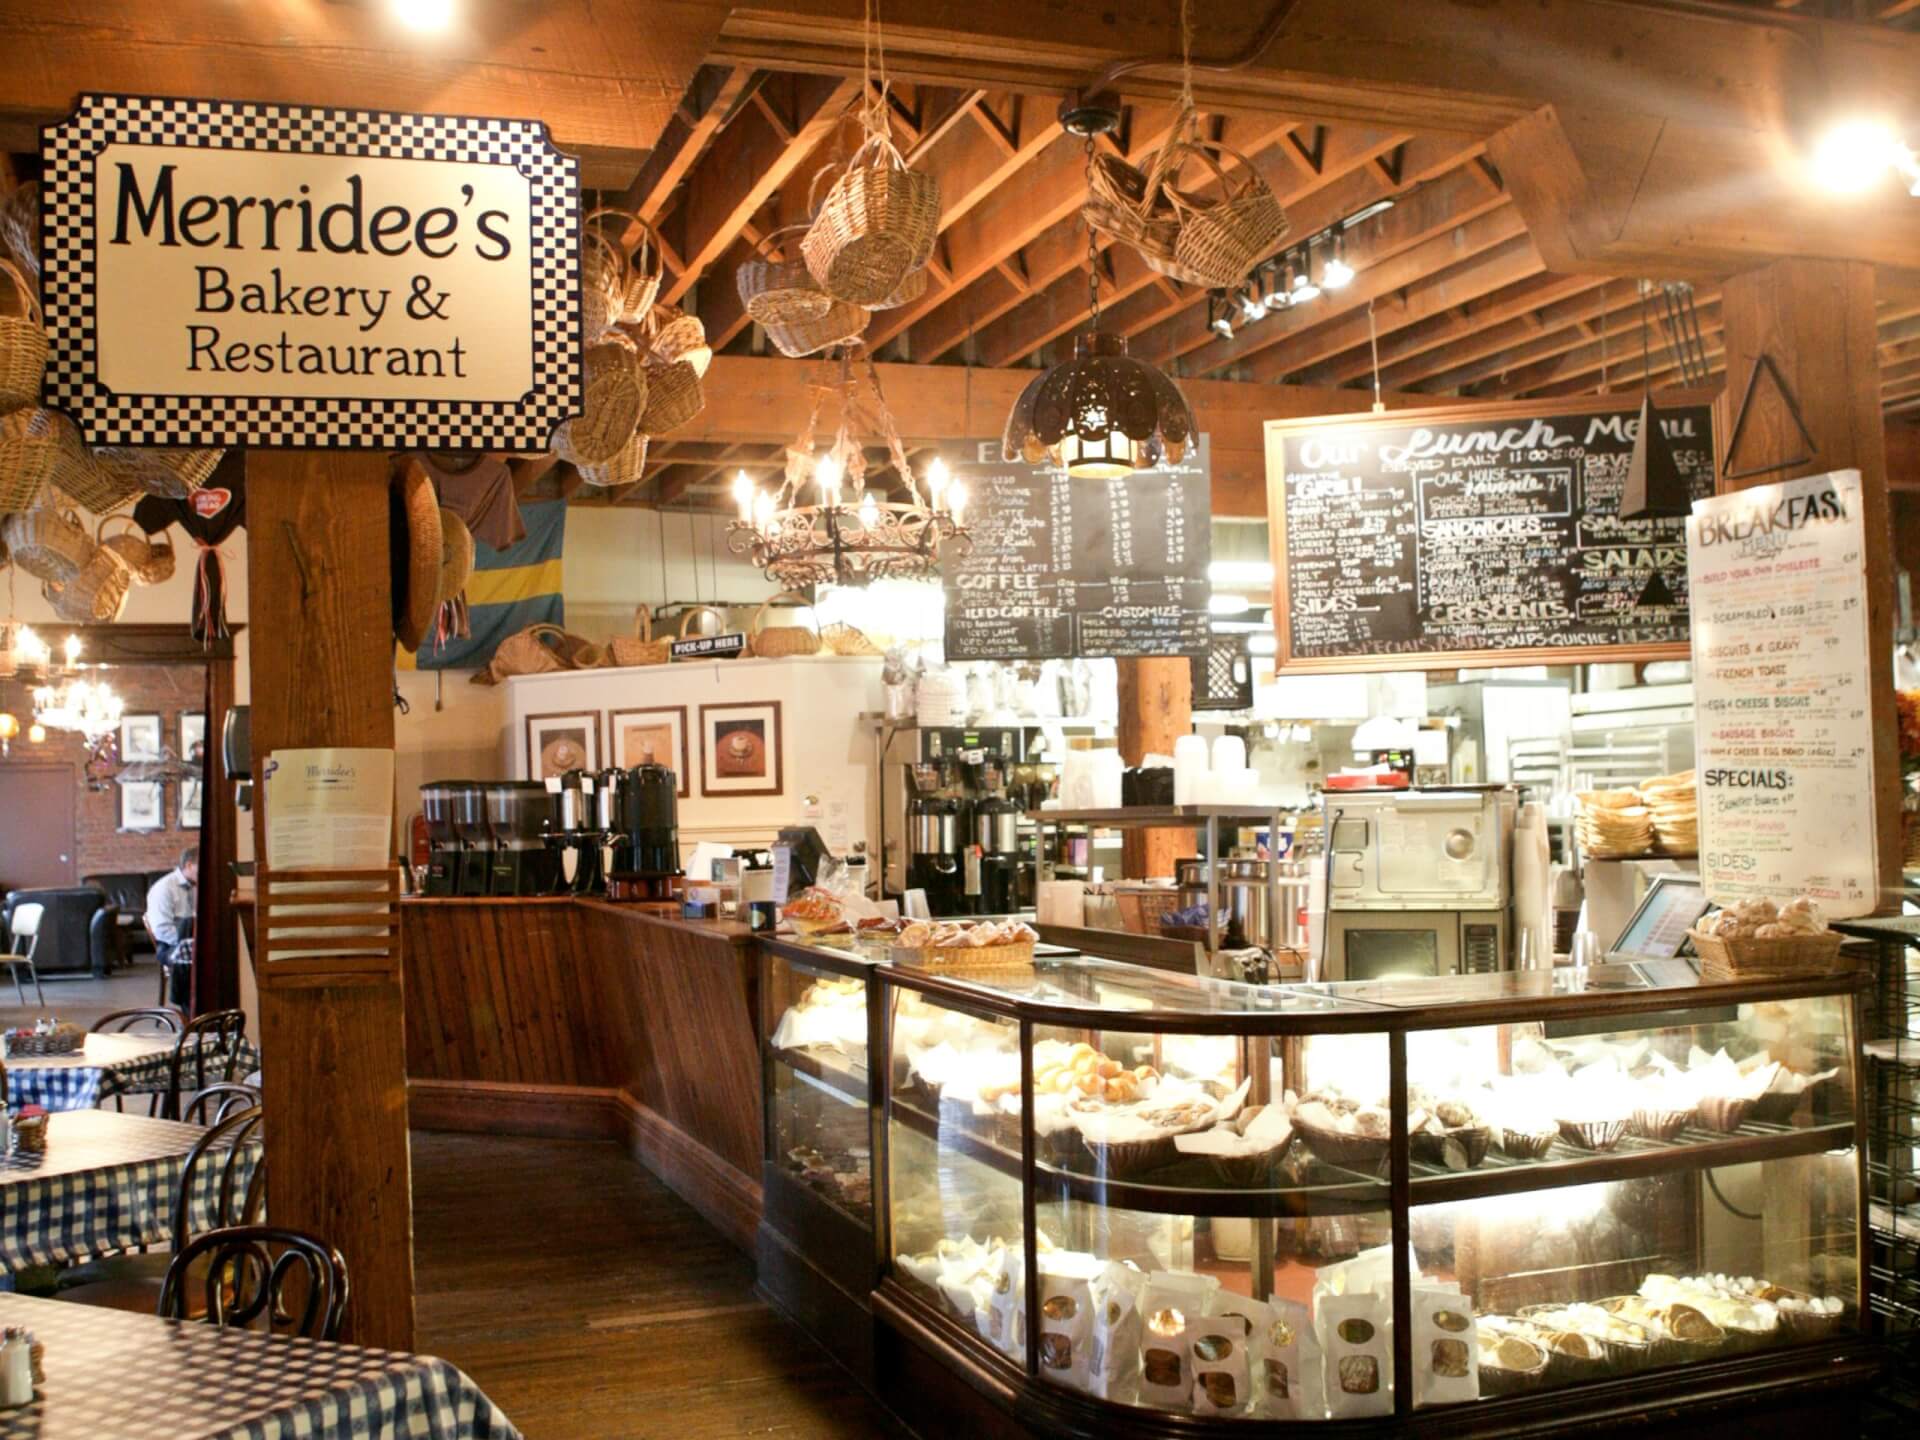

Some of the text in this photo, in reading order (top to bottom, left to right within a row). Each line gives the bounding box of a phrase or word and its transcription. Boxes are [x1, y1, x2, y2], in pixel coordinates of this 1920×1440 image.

[109, 161, 513, 261] Merridee's
[195, 265, 450, 332] Bakery &
[186, 324, 468, 379] Restaurant
[1300, 438, 1367, 468] Our
[1379, 419, 1574, 464] Lunch
[1451, 453, 1500, 467] DAILY
[1435, 468, 1507, 487] OUR HOUSE
[989, 507, 1025, 518] LATTE
[1697, 486, 1856, 548] BREAKFAST
[1335, 537, 1362, 546] CLUB
[1742, 532, 1788, 551] MENU
[1479, 559, 1505, 568] TUNA
[1583, 548, 1687, 570] SALADS
[1022, 564, 1048, 572] LATTE
[1297, 570, 1322, 579] BLT
[1731, 567, 1752, 578] YOUR
[1753, 565, 1773, 575] OWN
[956, 573, 1040, 590] COFFEE
[1000, 606, 1062, 618] COFFEE
[1102, 605, 1181, 618] CUSTOMIZE
[1295, 595, 1356, 614] SIDES
[1430, 601, 1568, 622] CRESCENTS
[1712, 606, 1805, 624] SCRAMBLED EGGS
[1082, 628, 1127, 637] ESPRESSO
[675, 637, 739, 654] PICK-UP HERE
[1294, 644, 1345, 657] CHECK
[1439, 635, 1486, 649] BOARD
[1493, 632, 1546, 649] SOUPS
[1768, 639, 1801, 652] GRAVY
[1715, 664, 1788, 679] FRENCH TOAST
[1708, 699, 1726, 711] EGG
[1735, 697, 1769, 709] CHEESE
[1774, 696, 1811, 708] BISCUIT
[1719, 728, 1795, 739] SAUSAGE BISCUIT
[1734, 747, 1760, 756] CHEESE
[1763, 747, 1780, 756] EGG
[1704, 769, 1794, 790] SPECIALS:
[1706, 852, 1757, 870] SIDES:
